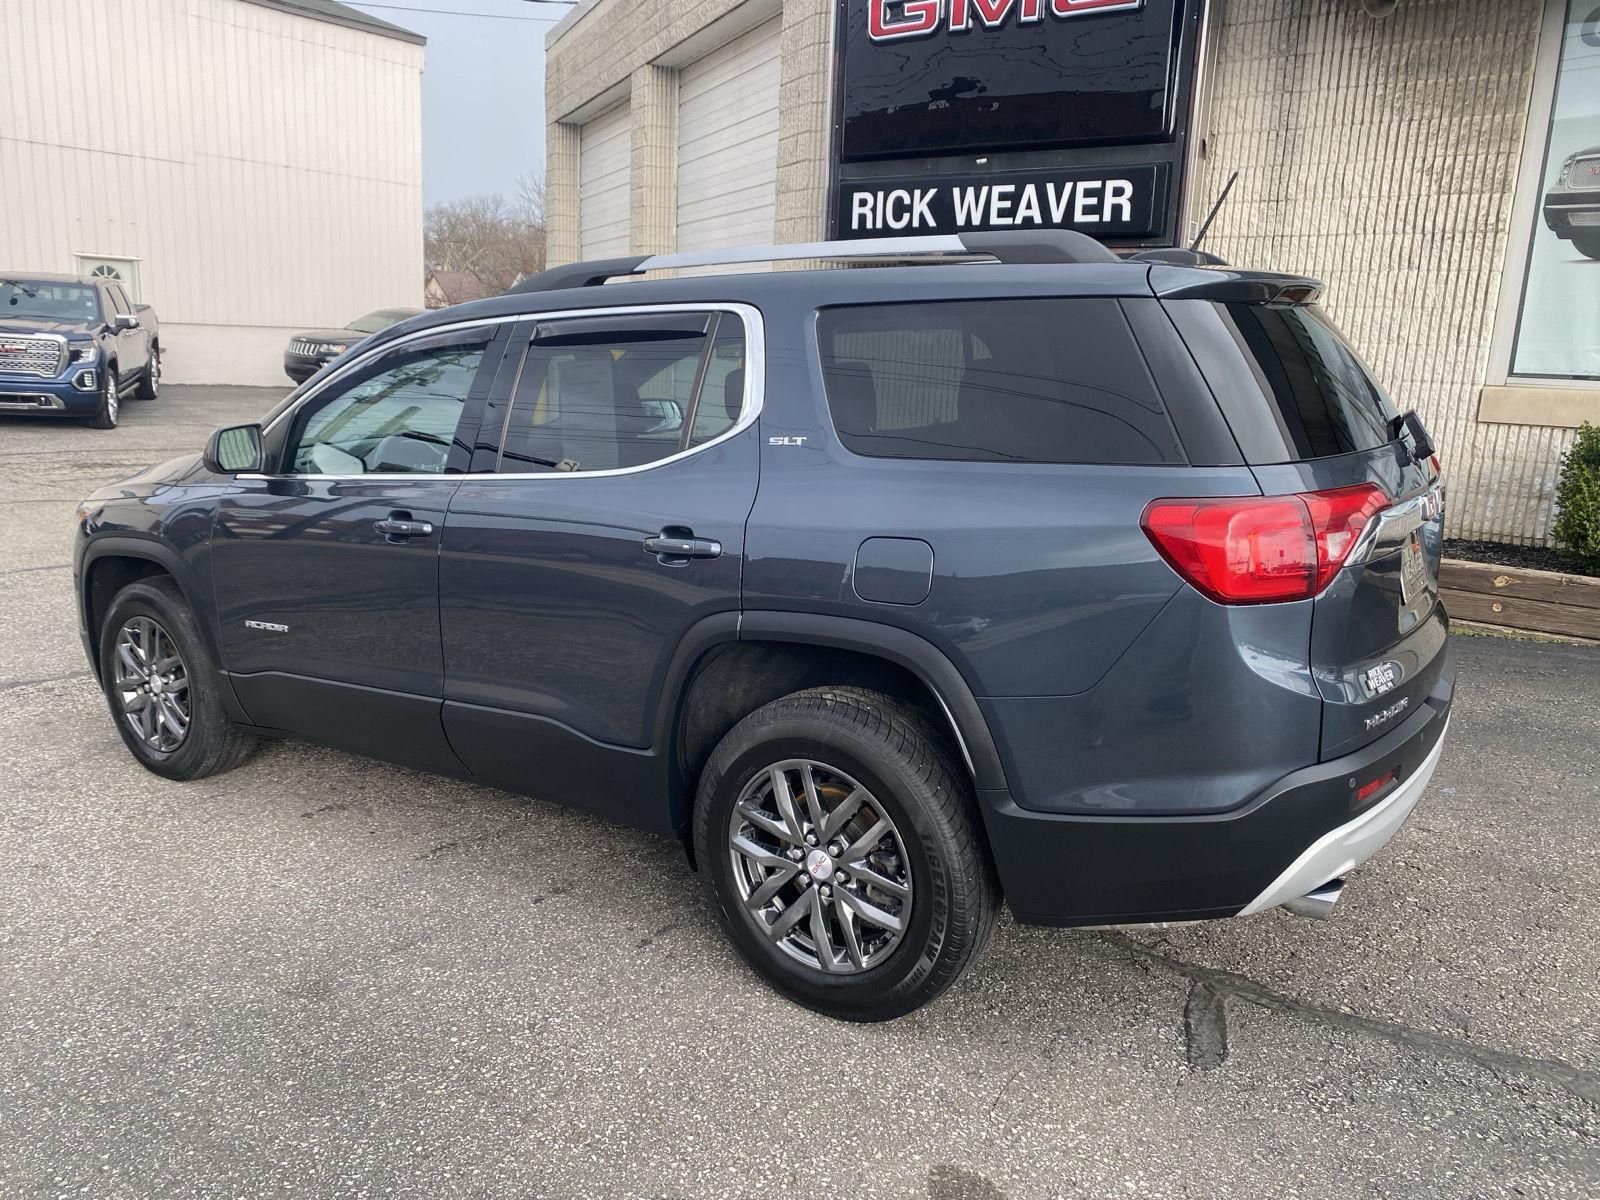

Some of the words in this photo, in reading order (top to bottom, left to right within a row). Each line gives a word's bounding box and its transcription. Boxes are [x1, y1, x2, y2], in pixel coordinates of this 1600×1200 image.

[868, 0, 1145, 41] GM
[852, 188, 938, 229] RICK
[953, 179, 1134, 227] WEAVER
[769, 436, 807, 446] SLT
[811, 856, 827, 874] GMC
